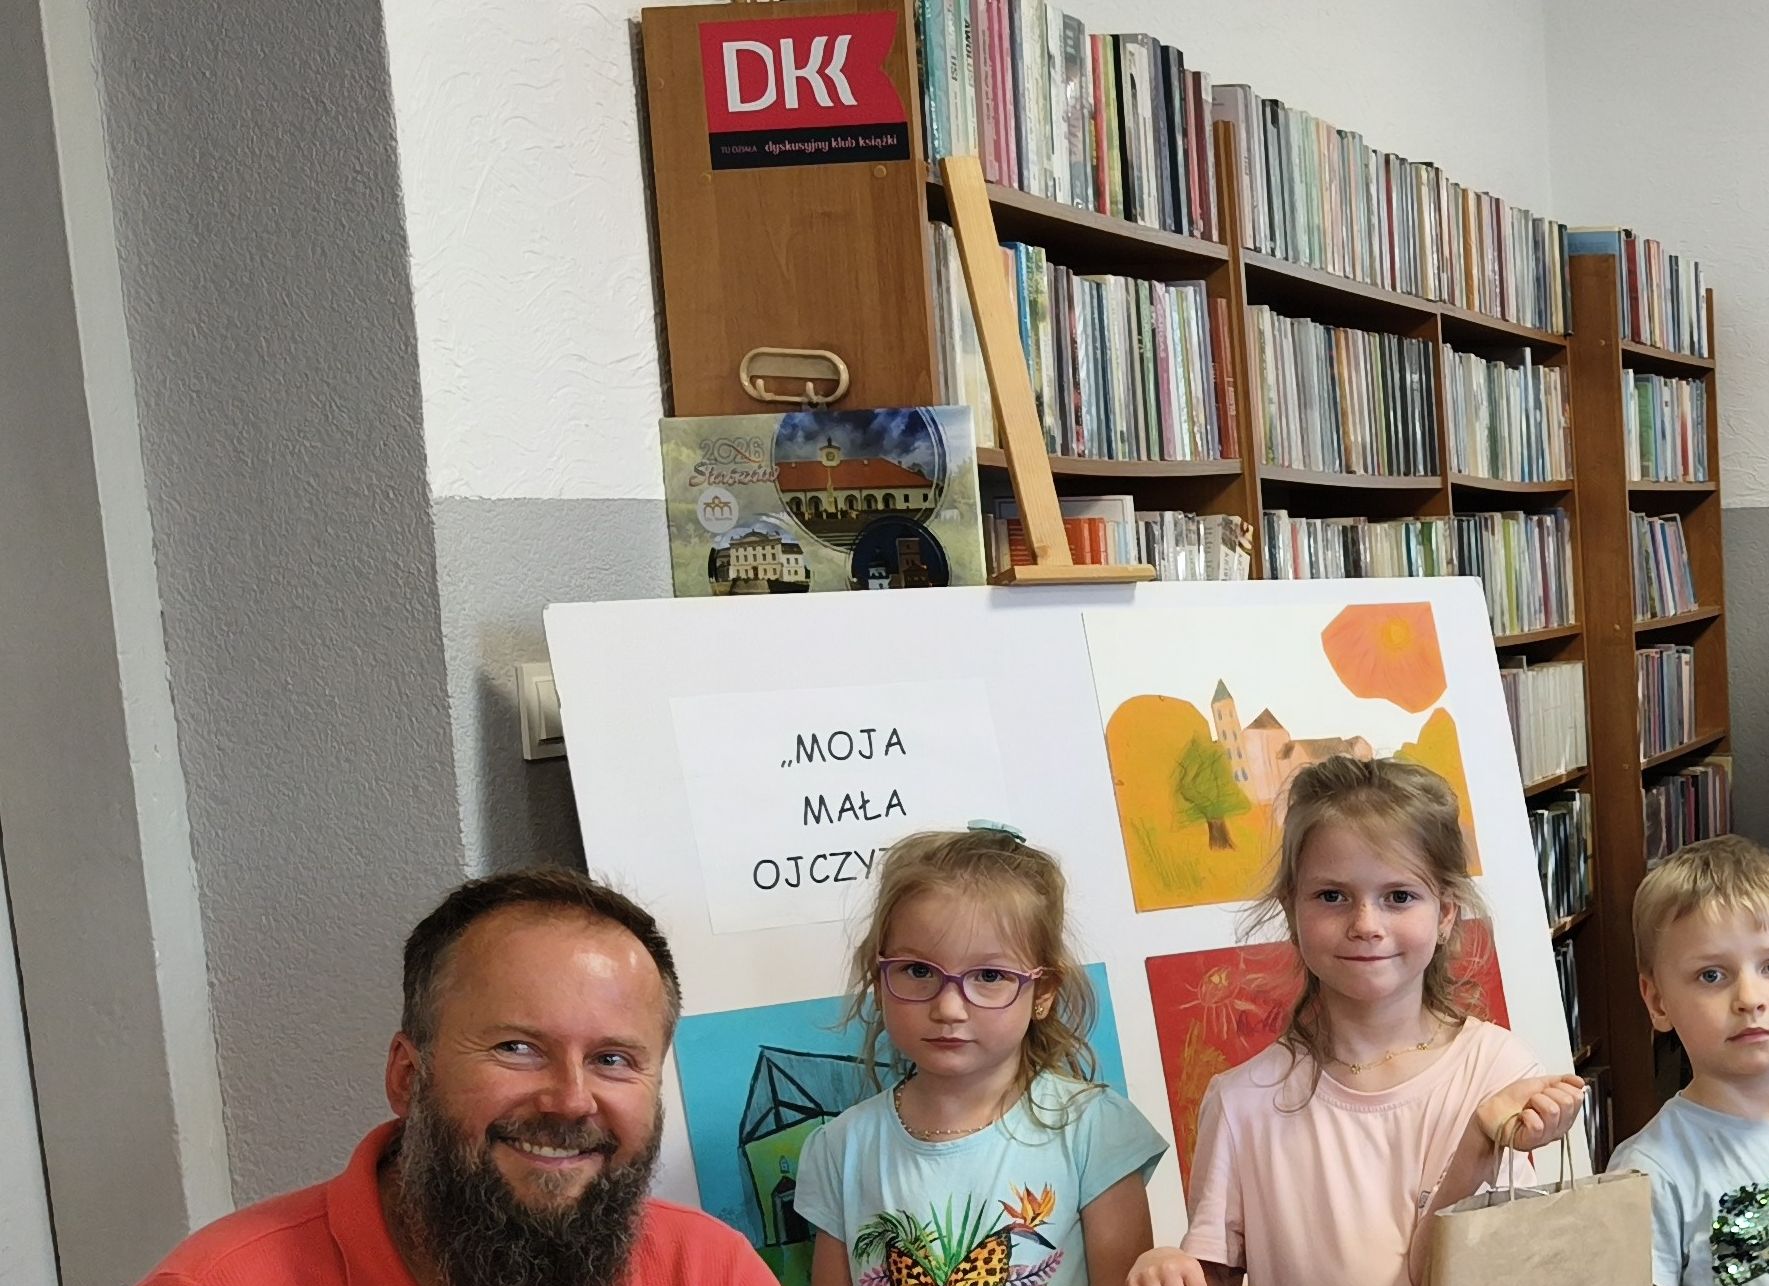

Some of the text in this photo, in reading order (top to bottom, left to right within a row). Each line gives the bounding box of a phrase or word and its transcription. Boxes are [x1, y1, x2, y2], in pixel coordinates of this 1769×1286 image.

[764, 139, 829, 156] dyskusyjny
[831, 137, 856, 150] klub
[858, 134, 898, 151] książki
[780, 726, 907, 769] „MOJA
[803, 788, 908, 827] MAŁA
[753, 845, 890, 892] OJCZY
